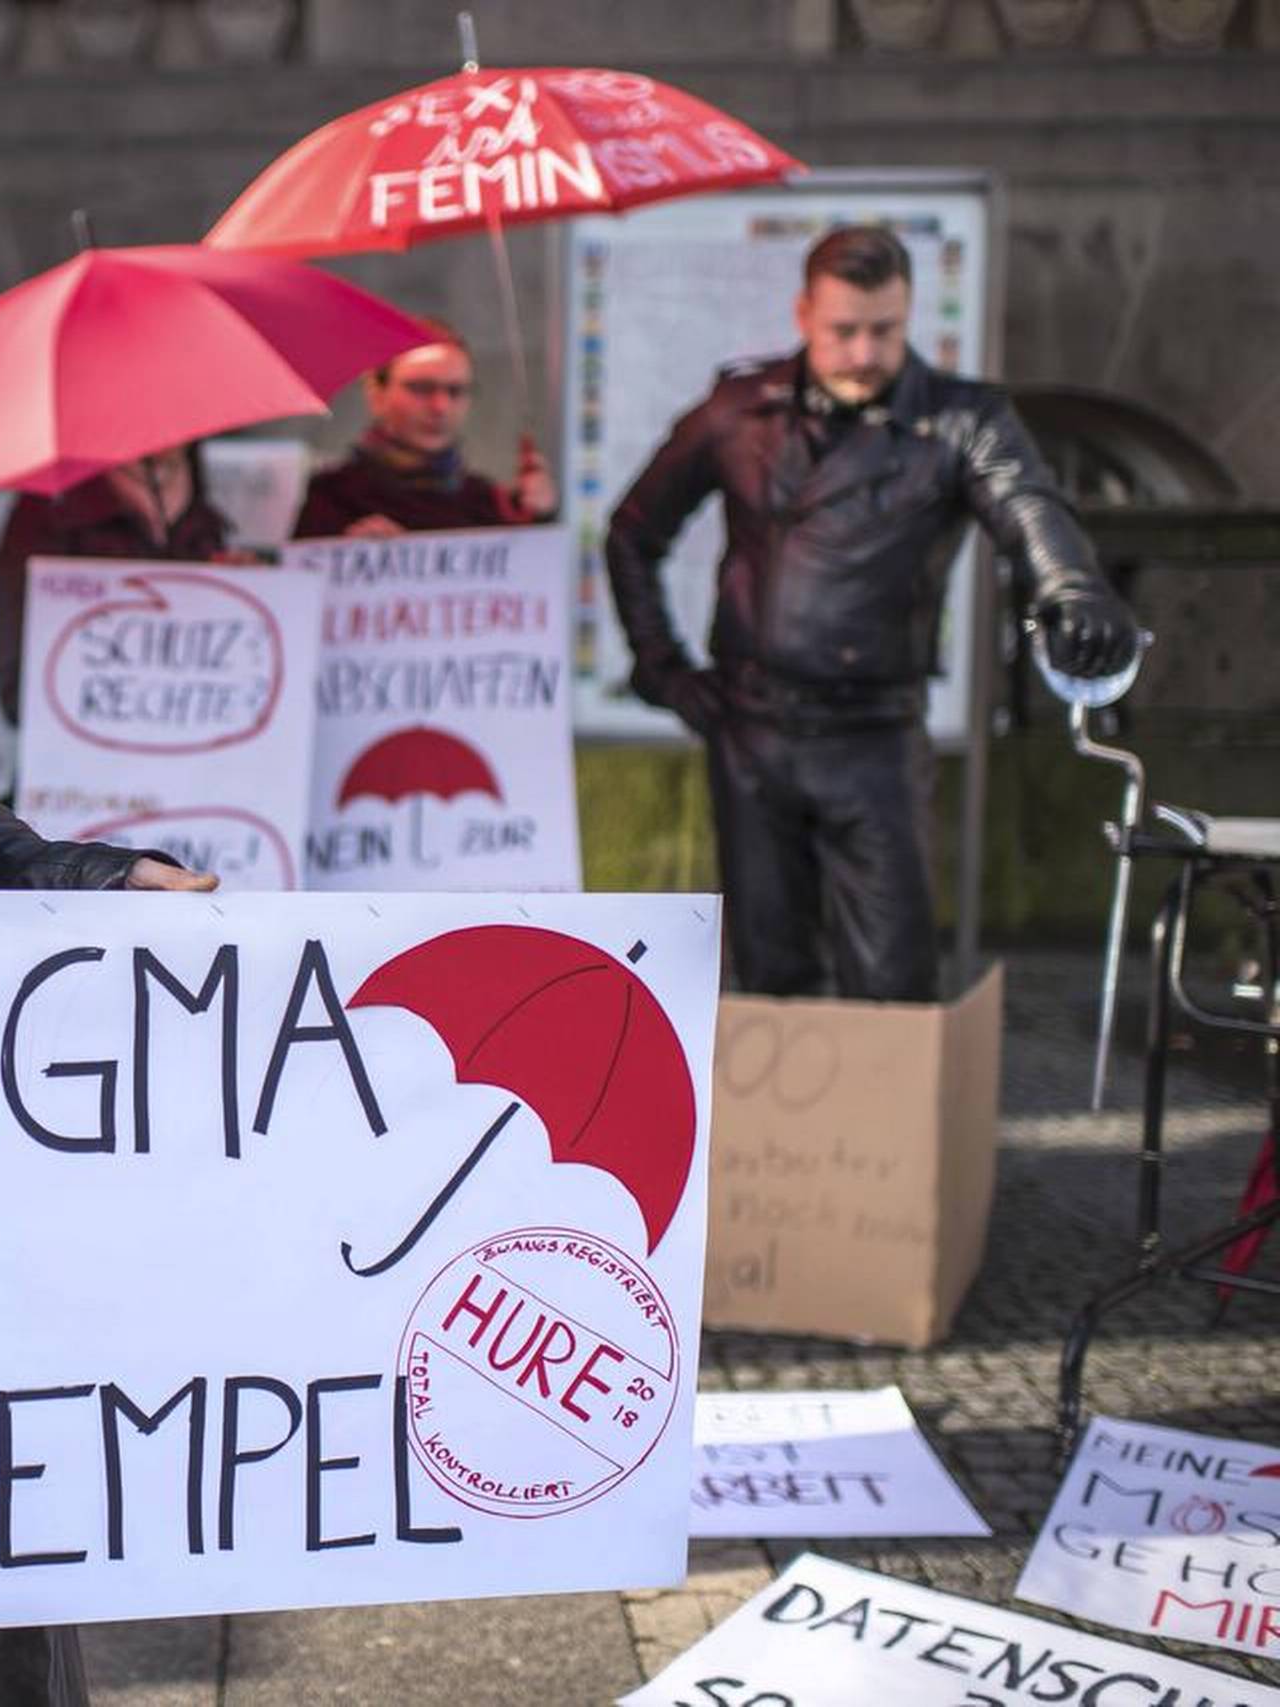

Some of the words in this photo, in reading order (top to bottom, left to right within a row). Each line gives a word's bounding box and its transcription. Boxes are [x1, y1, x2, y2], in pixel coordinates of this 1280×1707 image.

[441, 1273, 626, 1424] HURE
[410, 1351, 434, 1420] TOTAL
[612, 1404, 639, 1428] 18
[626, 1376, 656, 1401] 20
[422, 1431, 574, 1500] KONTROLLIERT
[1078, 1468, 1280, 1548] MÖS
